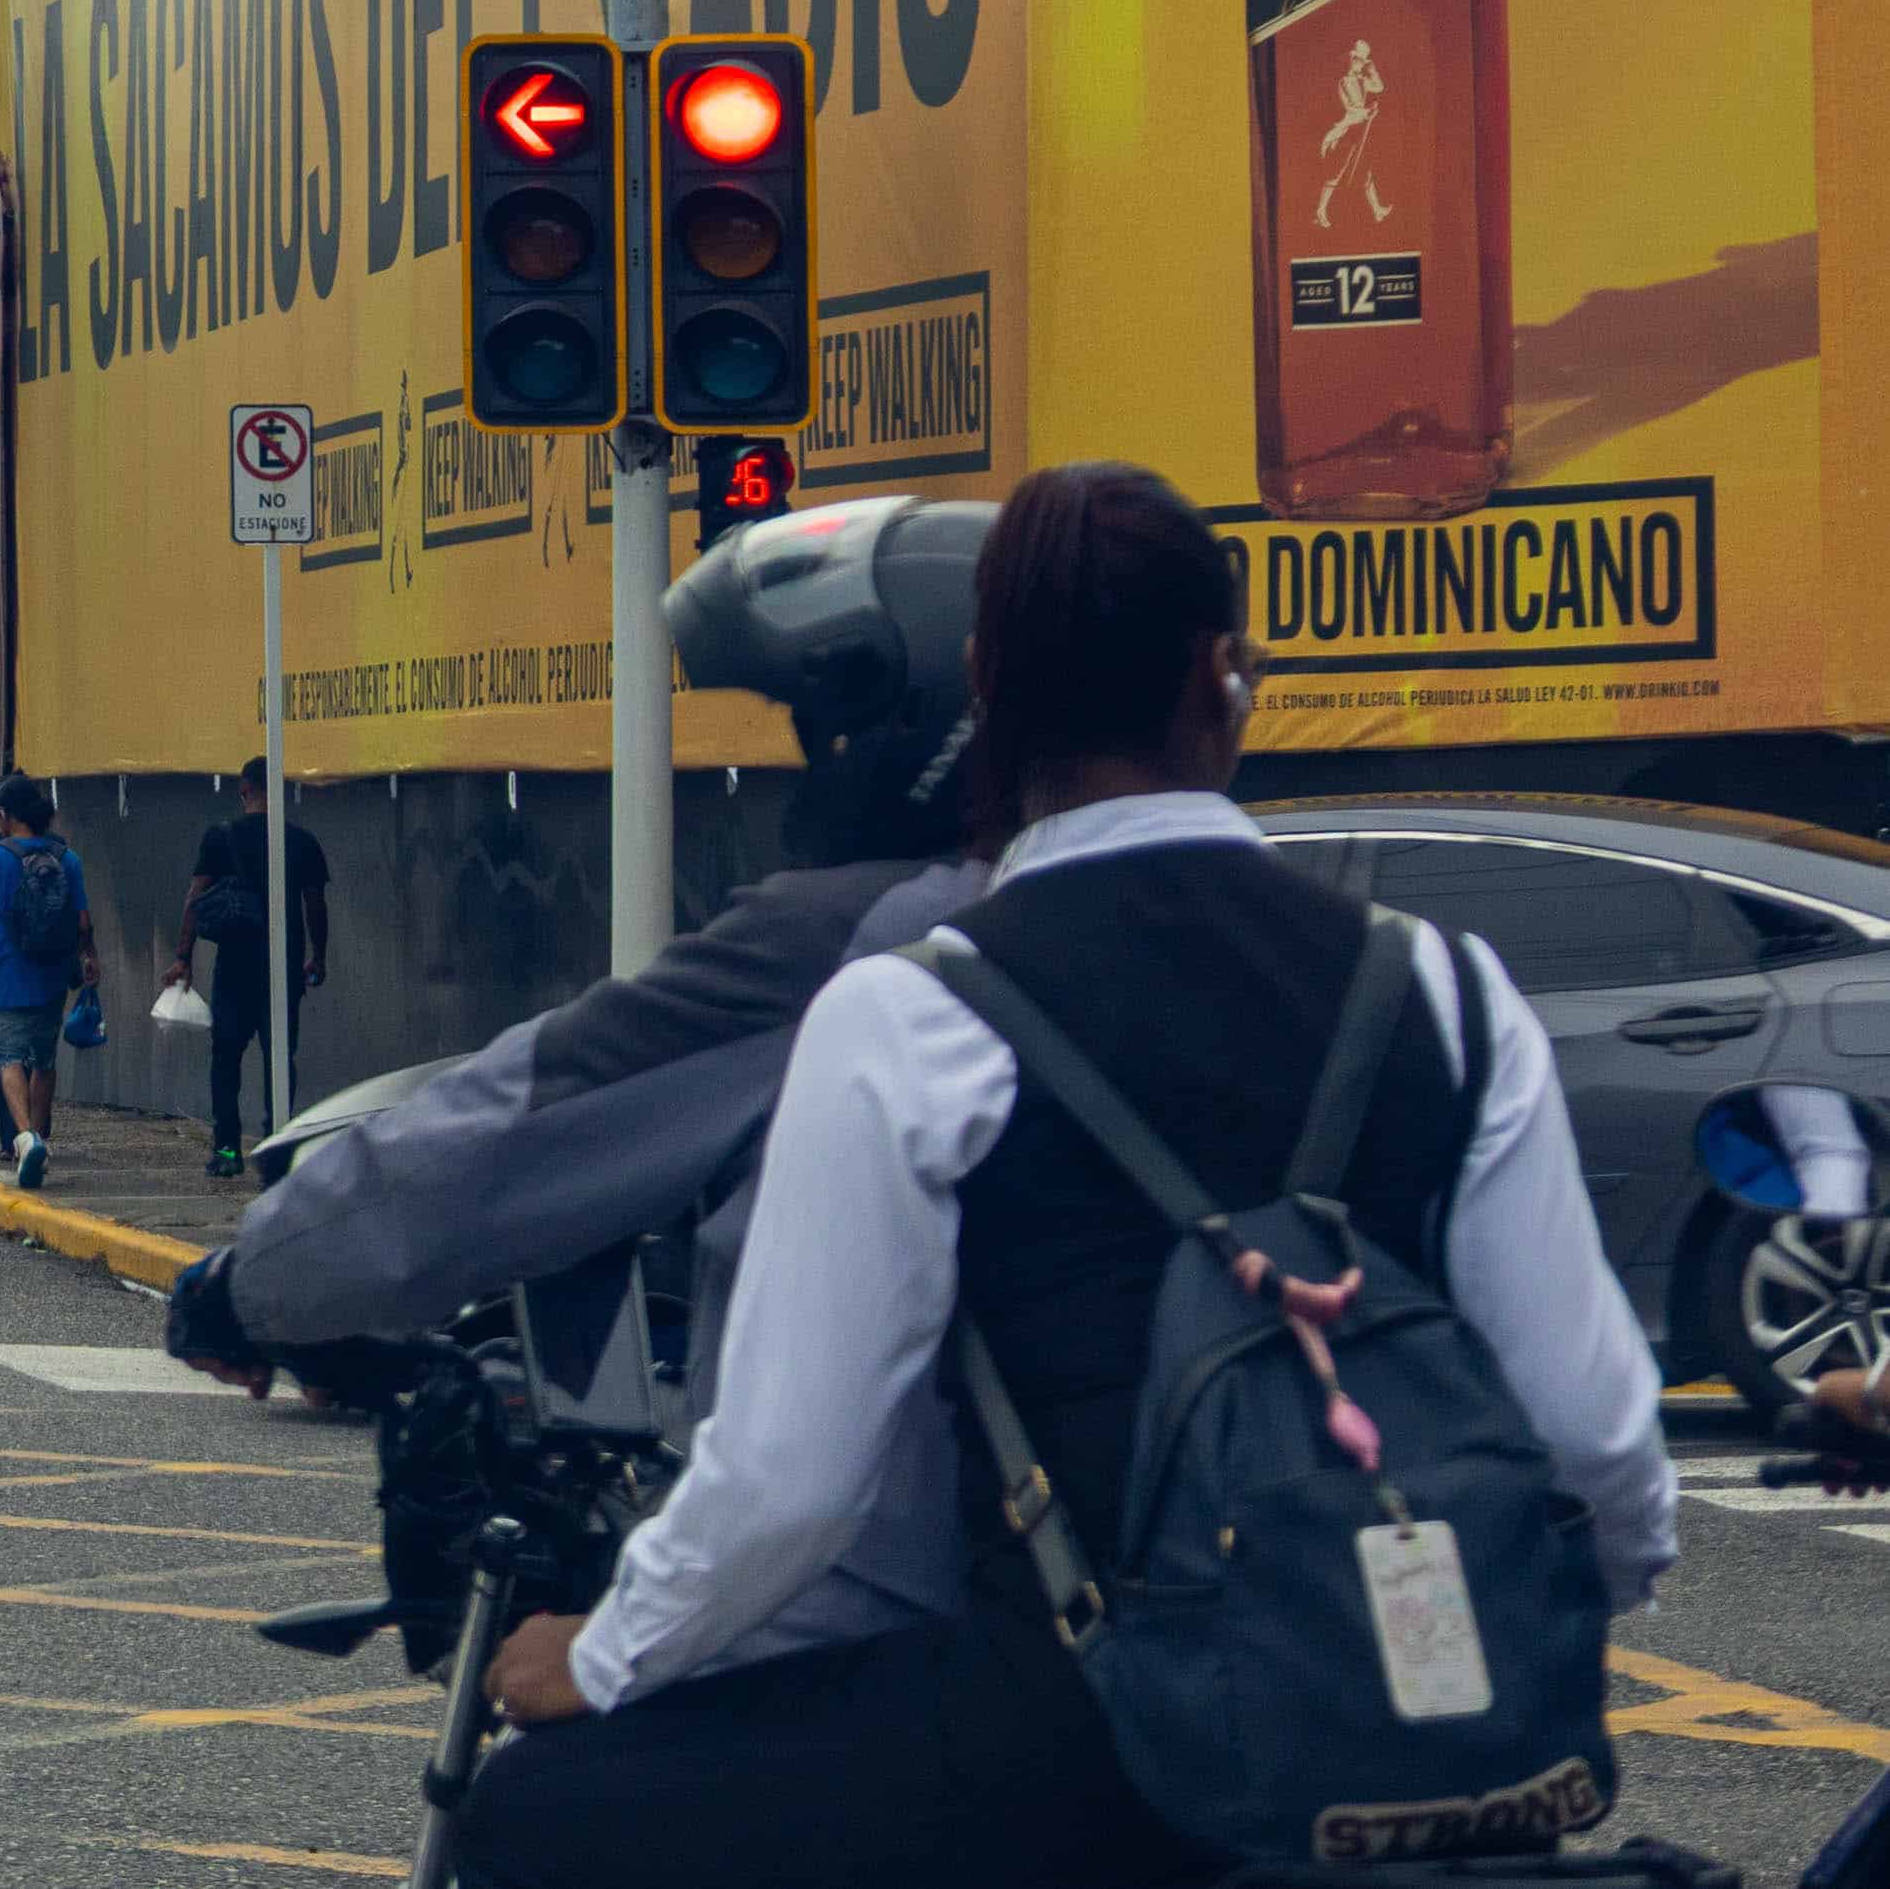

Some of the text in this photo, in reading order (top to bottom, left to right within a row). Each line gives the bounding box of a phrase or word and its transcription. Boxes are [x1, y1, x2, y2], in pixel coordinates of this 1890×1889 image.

[15, 0, 72, 385] LA
[1335, 264, 1376, 315] 12
[866, 310, 982, 444] WALKING
[259, 493, 286, 508] NO
[427, 420, 459, 520] KEEP
[239, 517, 307, 531] ESTACIONE
[1267, 511, 1684, 641] DOMINICANO
[396, 662, 407, 713] EL
[411, 655, 465, 711] CONSUMO
[469, 652, 484, 707] DE
[489, 647, 542, 704] ALCOHOL
[547, 641, 613, 702] PERJUDIC
[1267, 694, 1280, 710] EL
[1282, 693, 1335, 710] CONSUMO
[1339, 693, 1351, 708] DE
[1357, 690, 1406, 708] ALCOHOL
[1410, 688, 1473, 707] PERJUDICA
[1478, 688, 1491, 704] LA
[1495, 686, 1531, 703] SALUD
[1535, 685, 1556, 702] LEY
